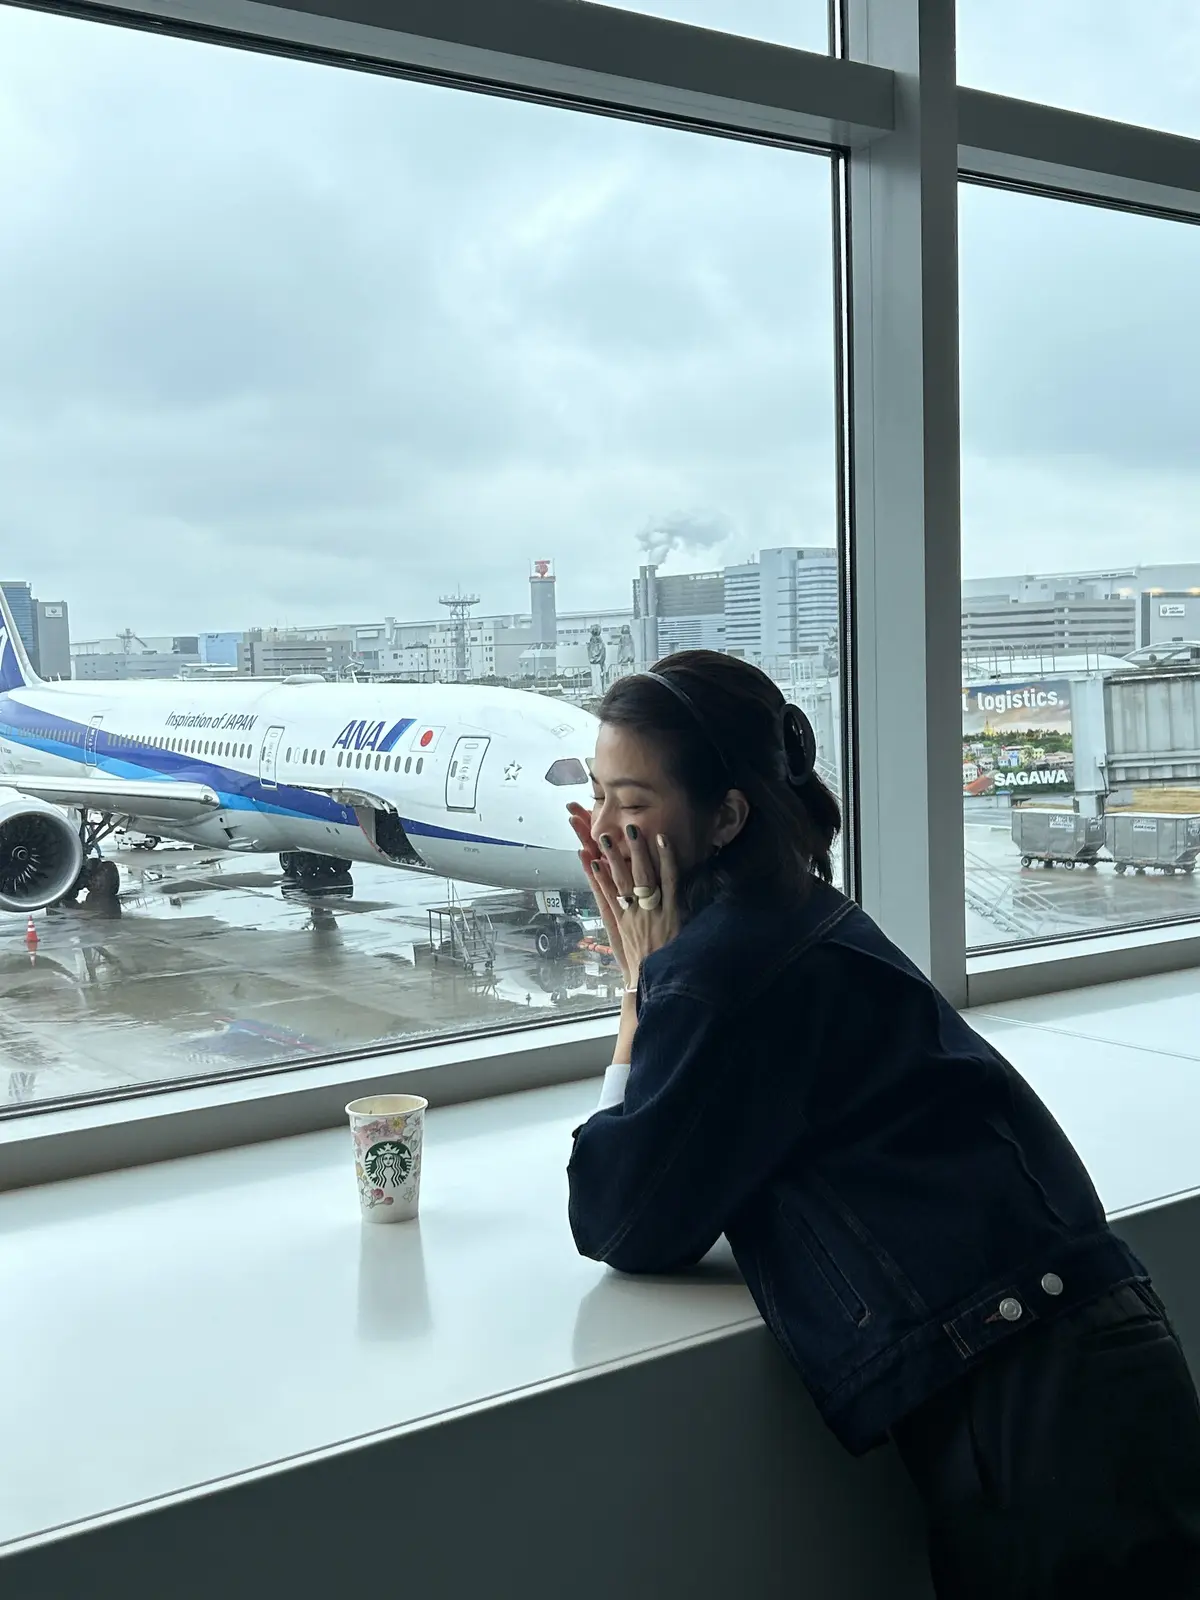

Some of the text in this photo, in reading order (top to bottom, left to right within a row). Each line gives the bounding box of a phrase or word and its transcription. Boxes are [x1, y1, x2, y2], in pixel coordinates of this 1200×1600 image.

[978, 688, 1064, 713] logistics.
[165, 711, 259, 730] Inspiration of JAPAN
[332, 719, 387, 751] ANA
[994, 769, 1069, 786] SAGAWA
[546, 897, 560, 908] 932
